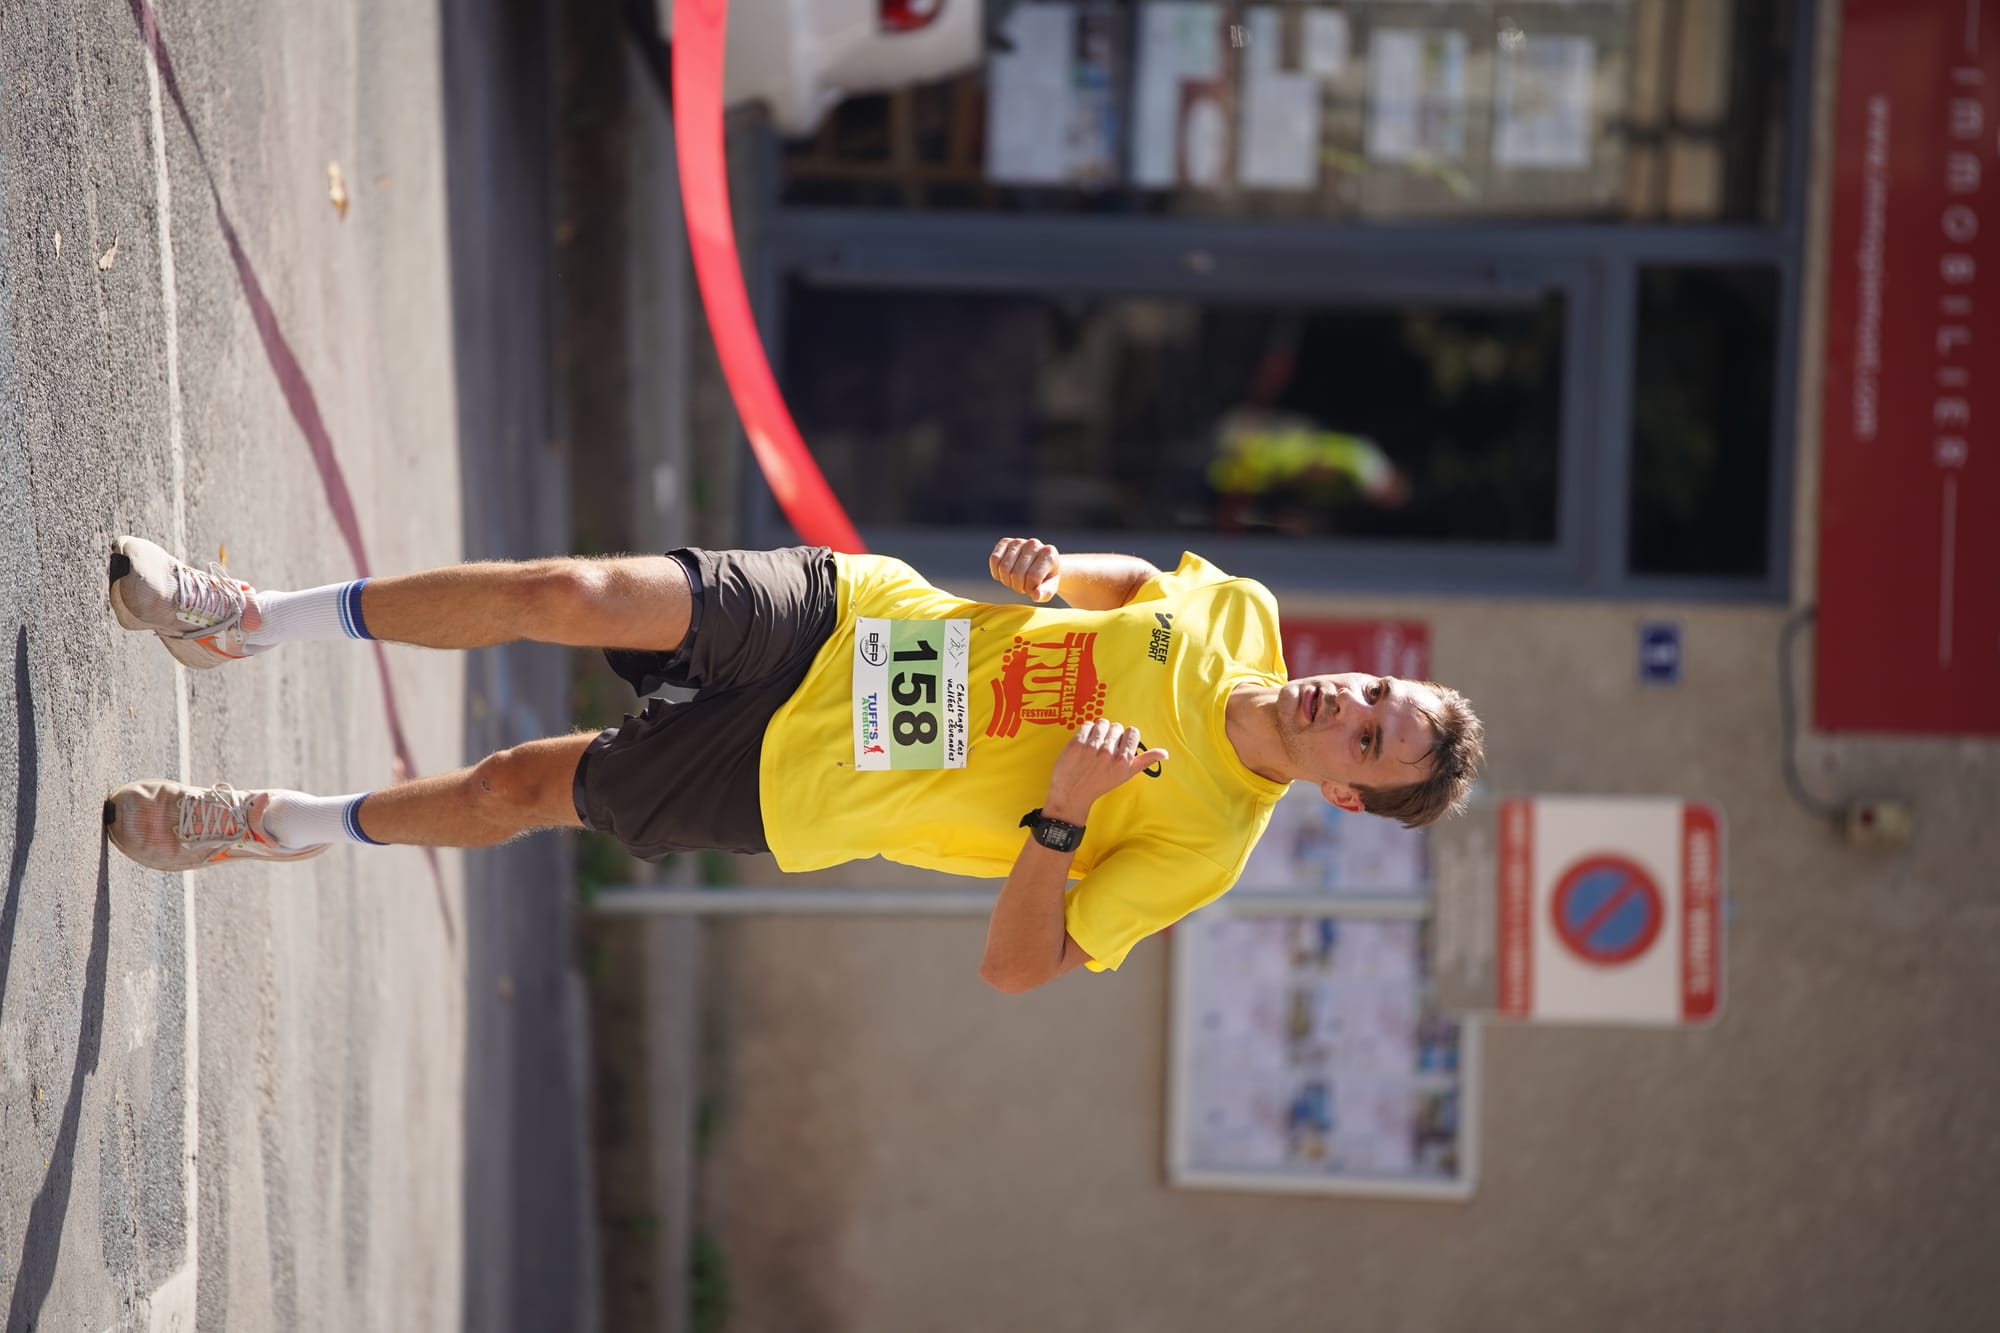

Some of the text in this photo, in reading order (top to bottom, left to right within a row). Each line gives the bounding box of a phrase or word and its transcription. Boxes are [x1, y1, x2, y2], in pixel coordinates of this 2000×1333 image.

[1933, 66, 1983, 470] IMMOBILIER
[868, 632, 879, 662] BFP
[1147, 628, 1162, 660] SPORT
[1157, 631, 1171, 662] INTER
[892, 640, 938, 745] 158
[1021, 647, 1066, 711] RUN
[1061, 647, 1082, 719] MONTPELLIER
[861, 697, 872, 746] Aventure
[868, 692, 878, 740] TUFF'S
[947, 678, 957, 762] vallées cévenoles
[954, 683, 965, 733] Challenge
[1022, 710, 1057, 719] FESTIVAL
